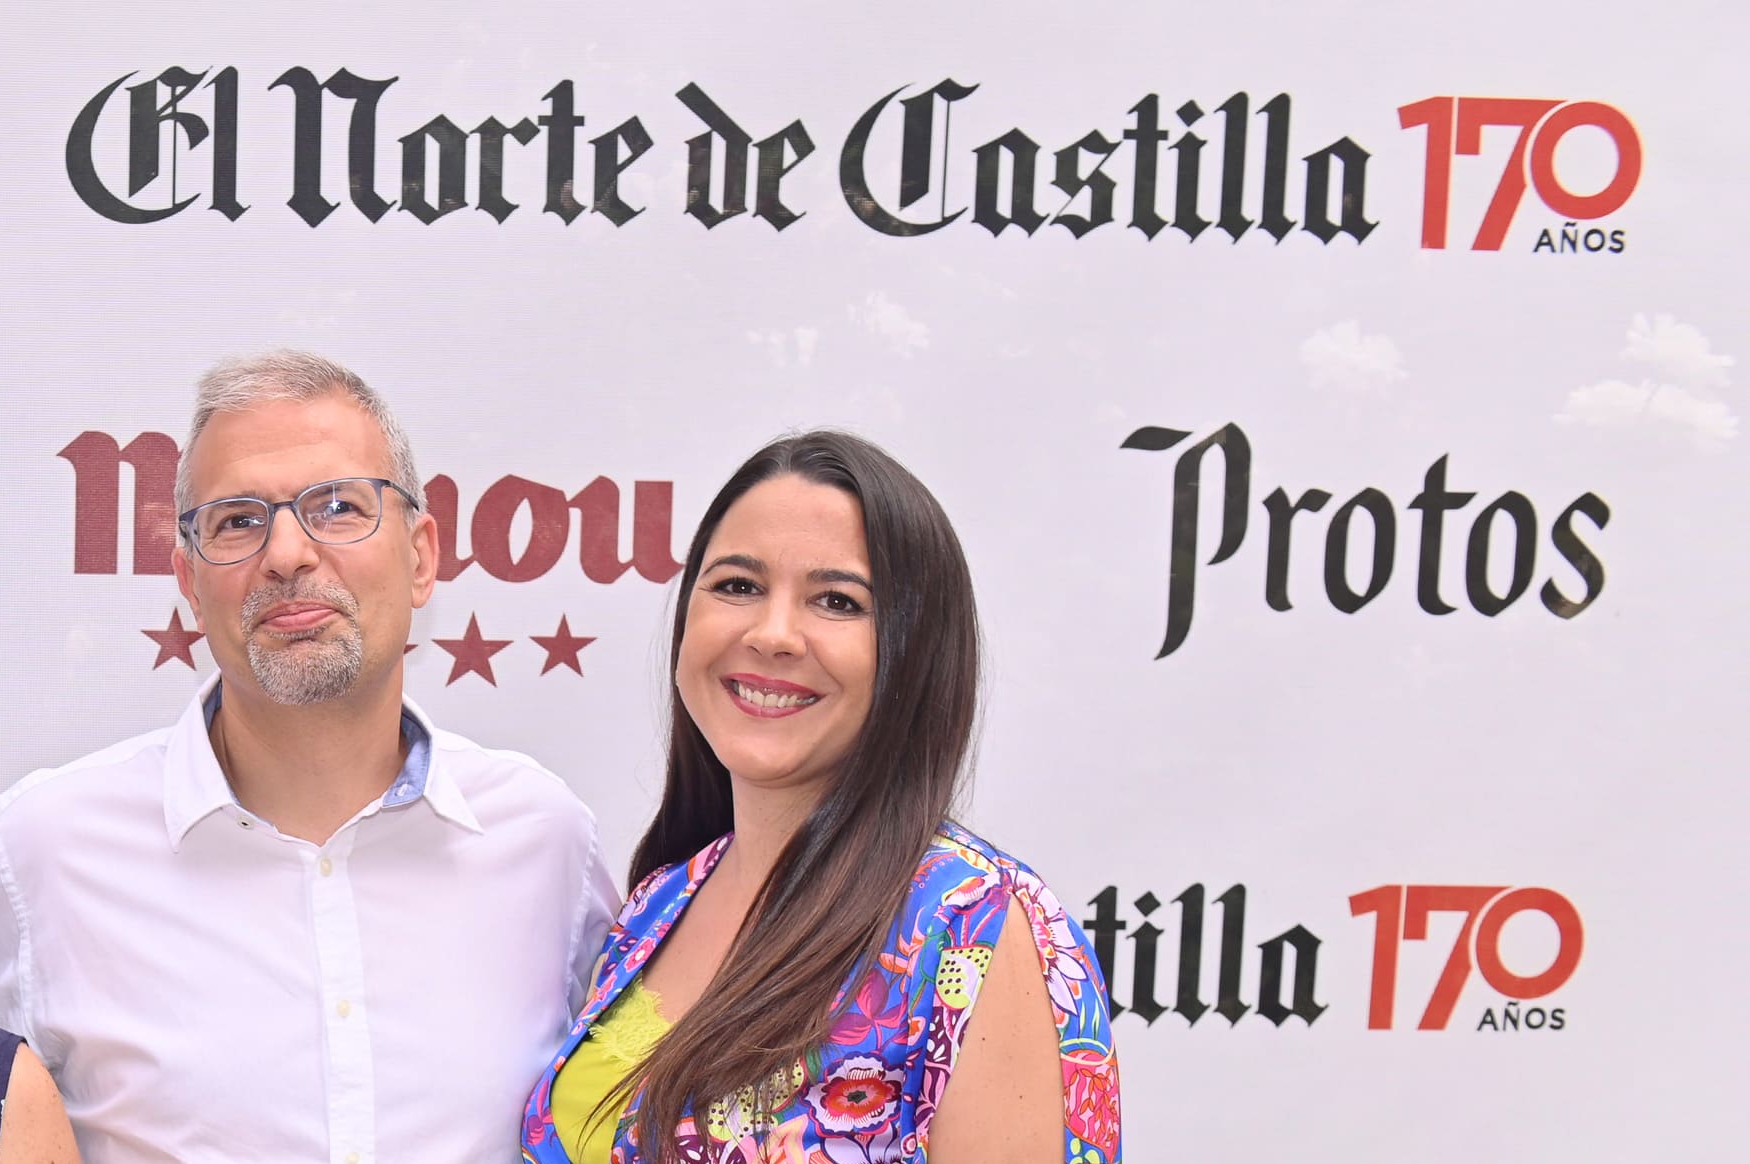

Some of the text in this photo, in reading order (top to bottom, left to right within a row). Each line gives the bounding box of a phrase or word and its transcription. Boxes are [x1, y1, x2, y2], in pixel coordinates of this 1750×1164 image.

[65, 65, 1643, 252] El Norte de Castilla 170
[1533, 221, 1626, 255] AÑOS
[1119, 421, 1612, 662] Protos
[1347, 884, 1584, 1032] 170
[1477, 1001, 1566, 1033] AÑOS
